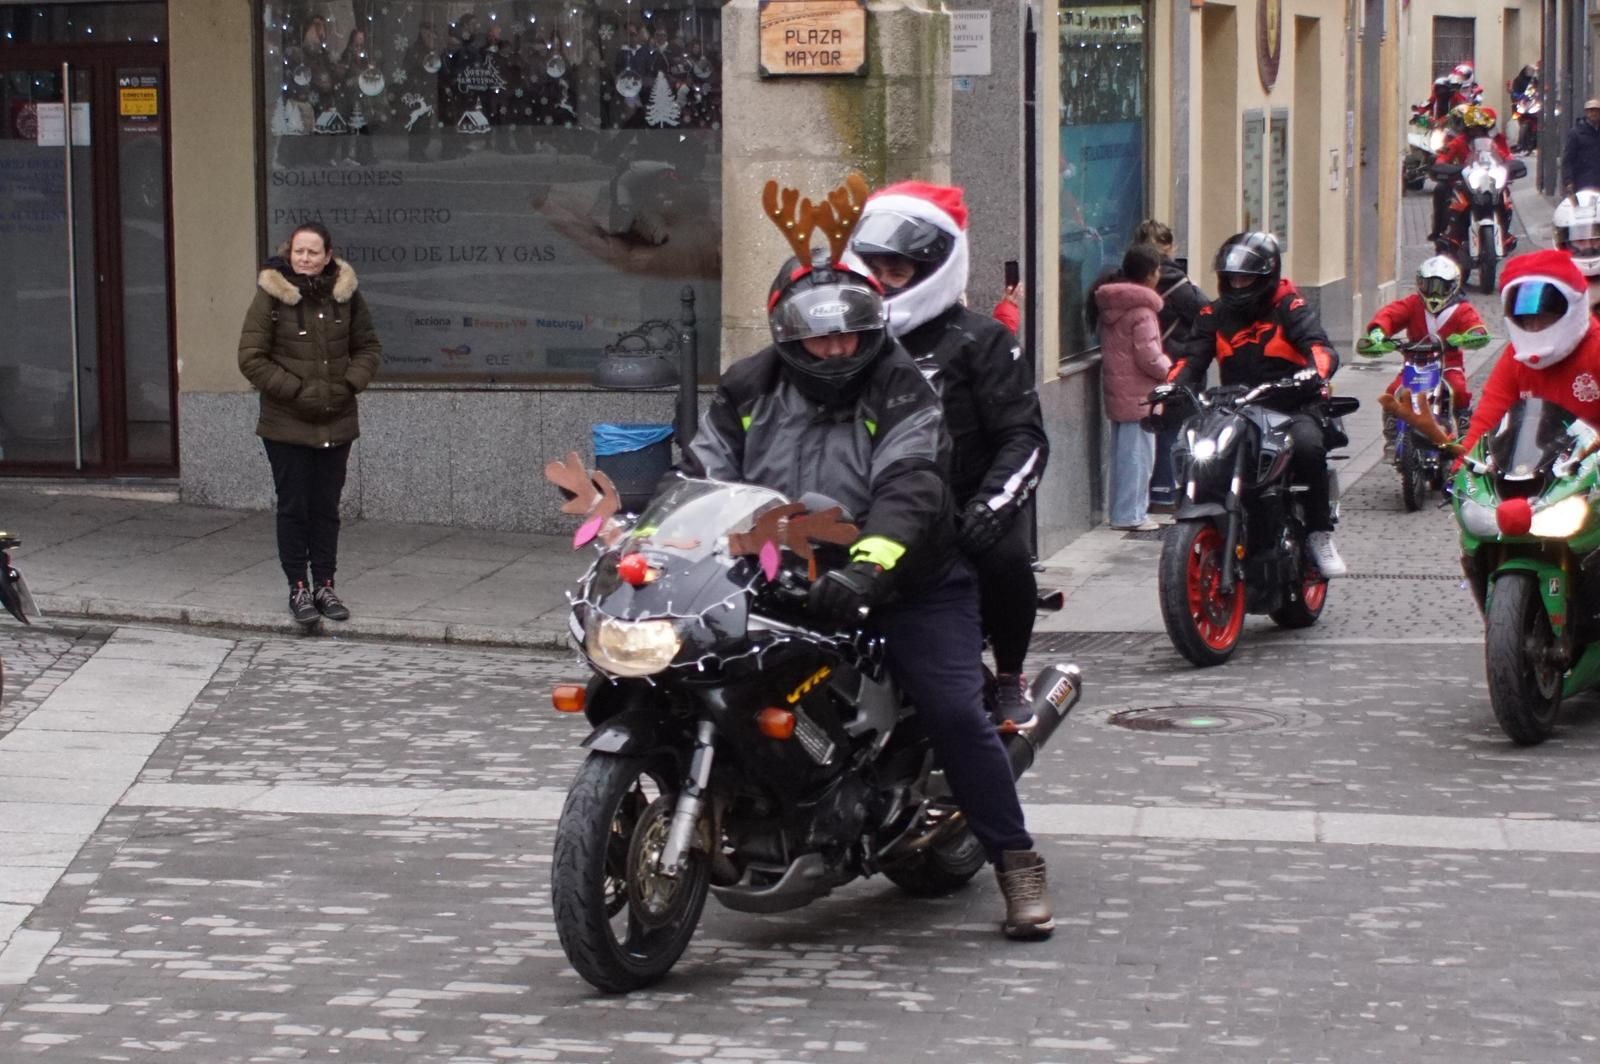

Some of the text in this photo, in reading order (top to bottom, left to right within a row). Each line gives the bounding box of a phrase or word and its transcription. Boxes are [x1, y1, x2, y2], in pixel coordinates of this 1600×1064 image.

[785, 30, 841, 44] PLAZA
[785, 50, 841, 66] MAYOR
[272, 170, 403, 187] SOLUCIONES
[274, 207, 452, 225] PARA TU AHORRO
[414, 246, 442, 262] DE
[450, 246, 488, 262] LUZ
[495, 246, 506, 262] Y
[513, 246, 556, 262] GAS
[414, 316, 451, 326] acciona
[536, 318, 583, 330] Naturgy
